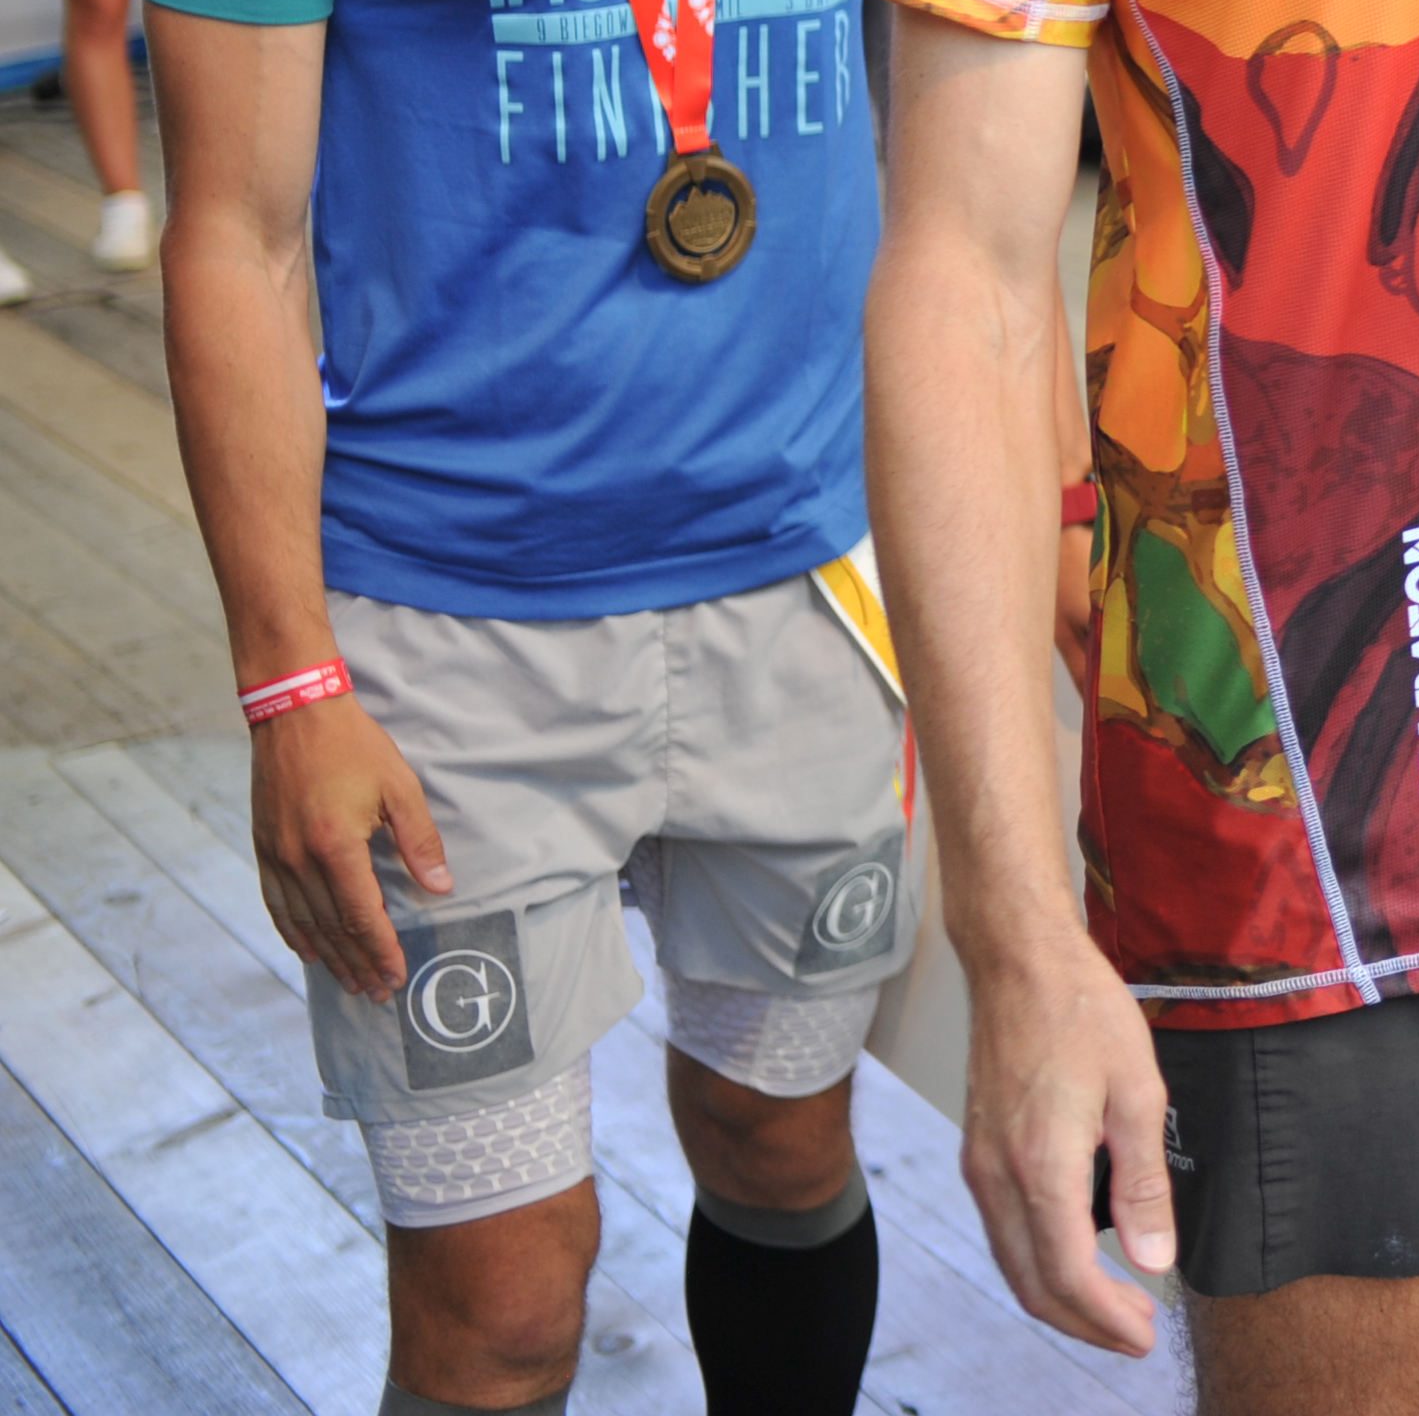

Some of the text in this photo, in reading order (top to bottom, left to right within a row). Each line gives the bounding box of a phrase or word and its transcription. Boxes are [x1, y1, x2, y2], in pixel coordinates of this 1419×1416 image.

[536, 16, 547, 43] 9
[496, 9, 851, 164] FINIHER
[827, 867, 882, 942] G
[421, 960, 501, 1039] G
